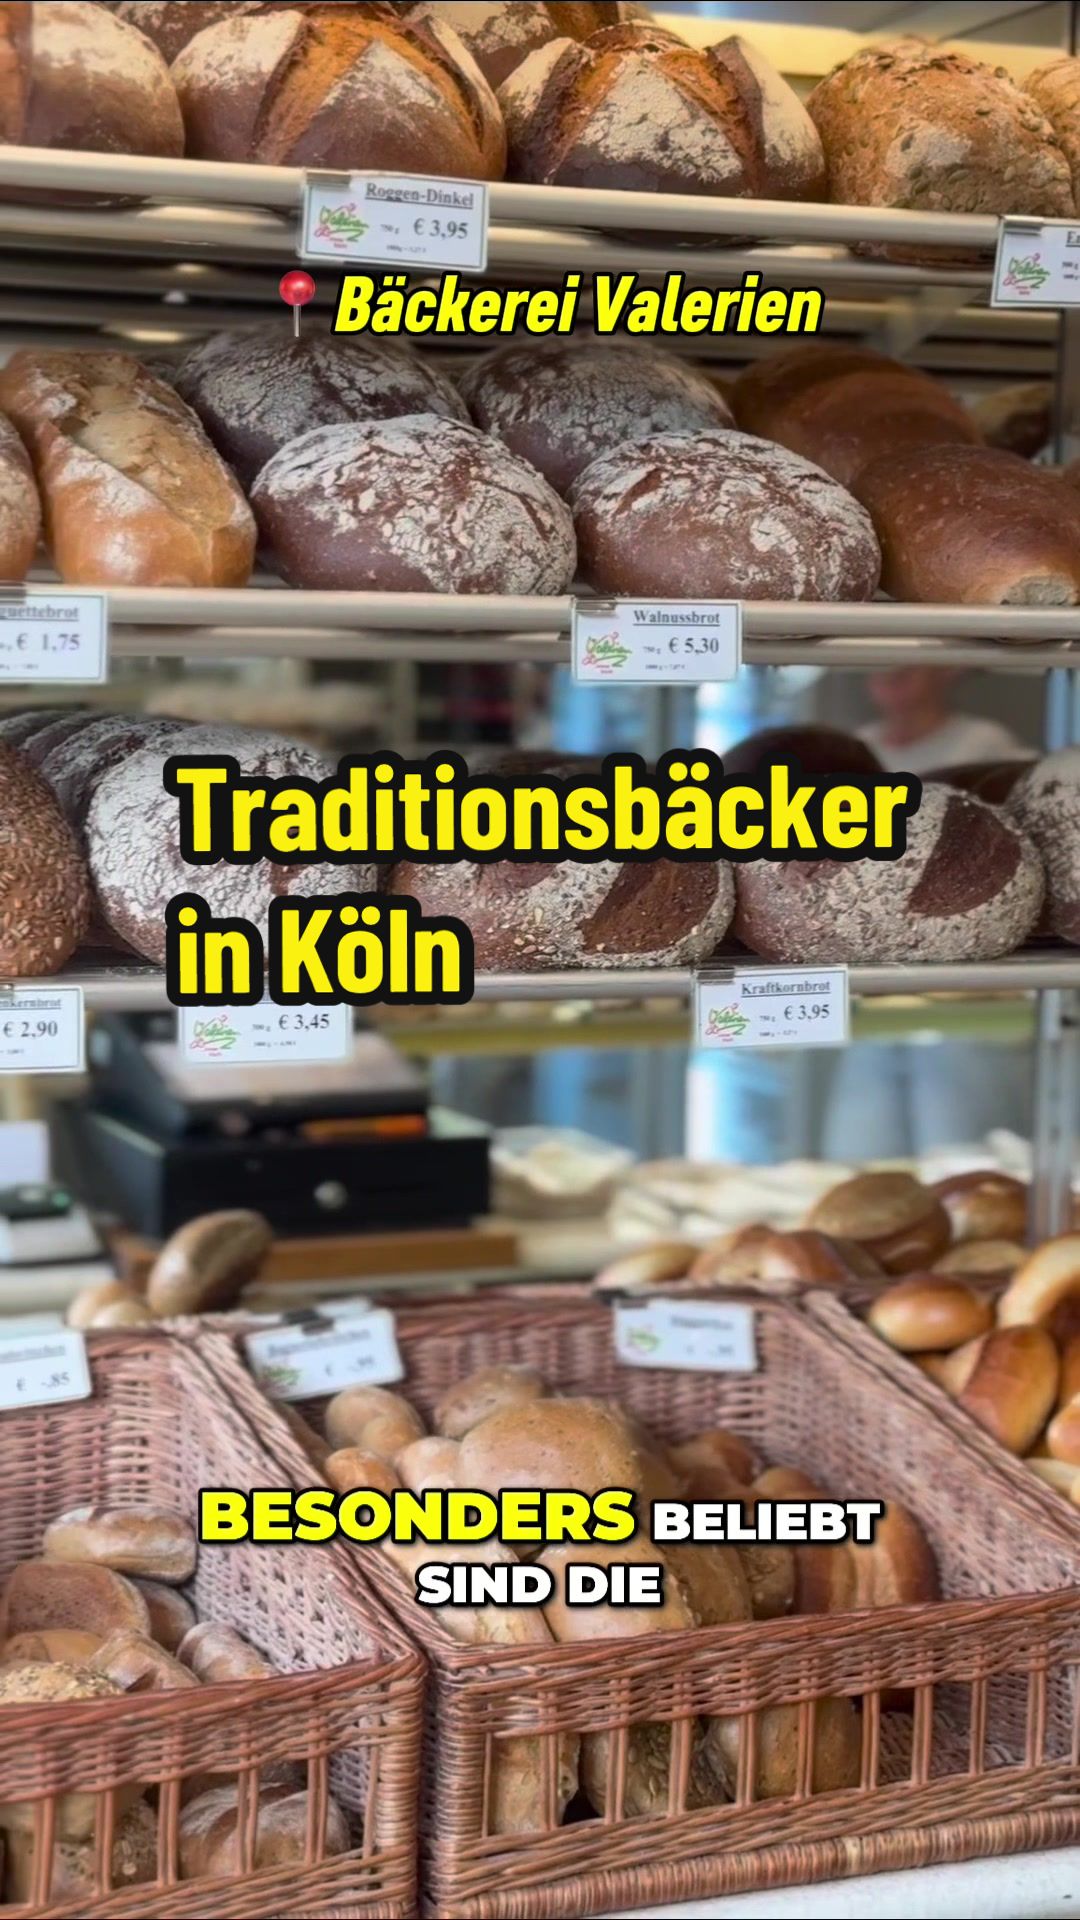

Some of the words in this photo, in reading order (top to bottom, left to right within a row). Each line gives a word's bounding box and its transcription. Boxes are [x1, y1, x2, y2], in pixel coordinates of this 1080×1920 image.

[365, 181, 474, 208] Roggen-Dinkel
[413, 217, 425, 235] €
[429, 219, 469, 239] 3,95
[633, 609, 720, 624] Walnussbrot
[16, 632, 28, 651] €
[42, 632, 80, 652] 1,75
[669, 636, 680, 654] €
[684, 637, 720, 656] 5,30
[741, 980, 831, 996] Kraftkornbrot
[278, 1013, 289, 1031] €
[294, 1013, 330, 1031] 3,45
[784, 1005, 794, 1021] €
[797, 1004, 830, 1021] 3,95
[3, 1020, 15, 1038] €
[20, 1020, 59, 1039] 2,90
